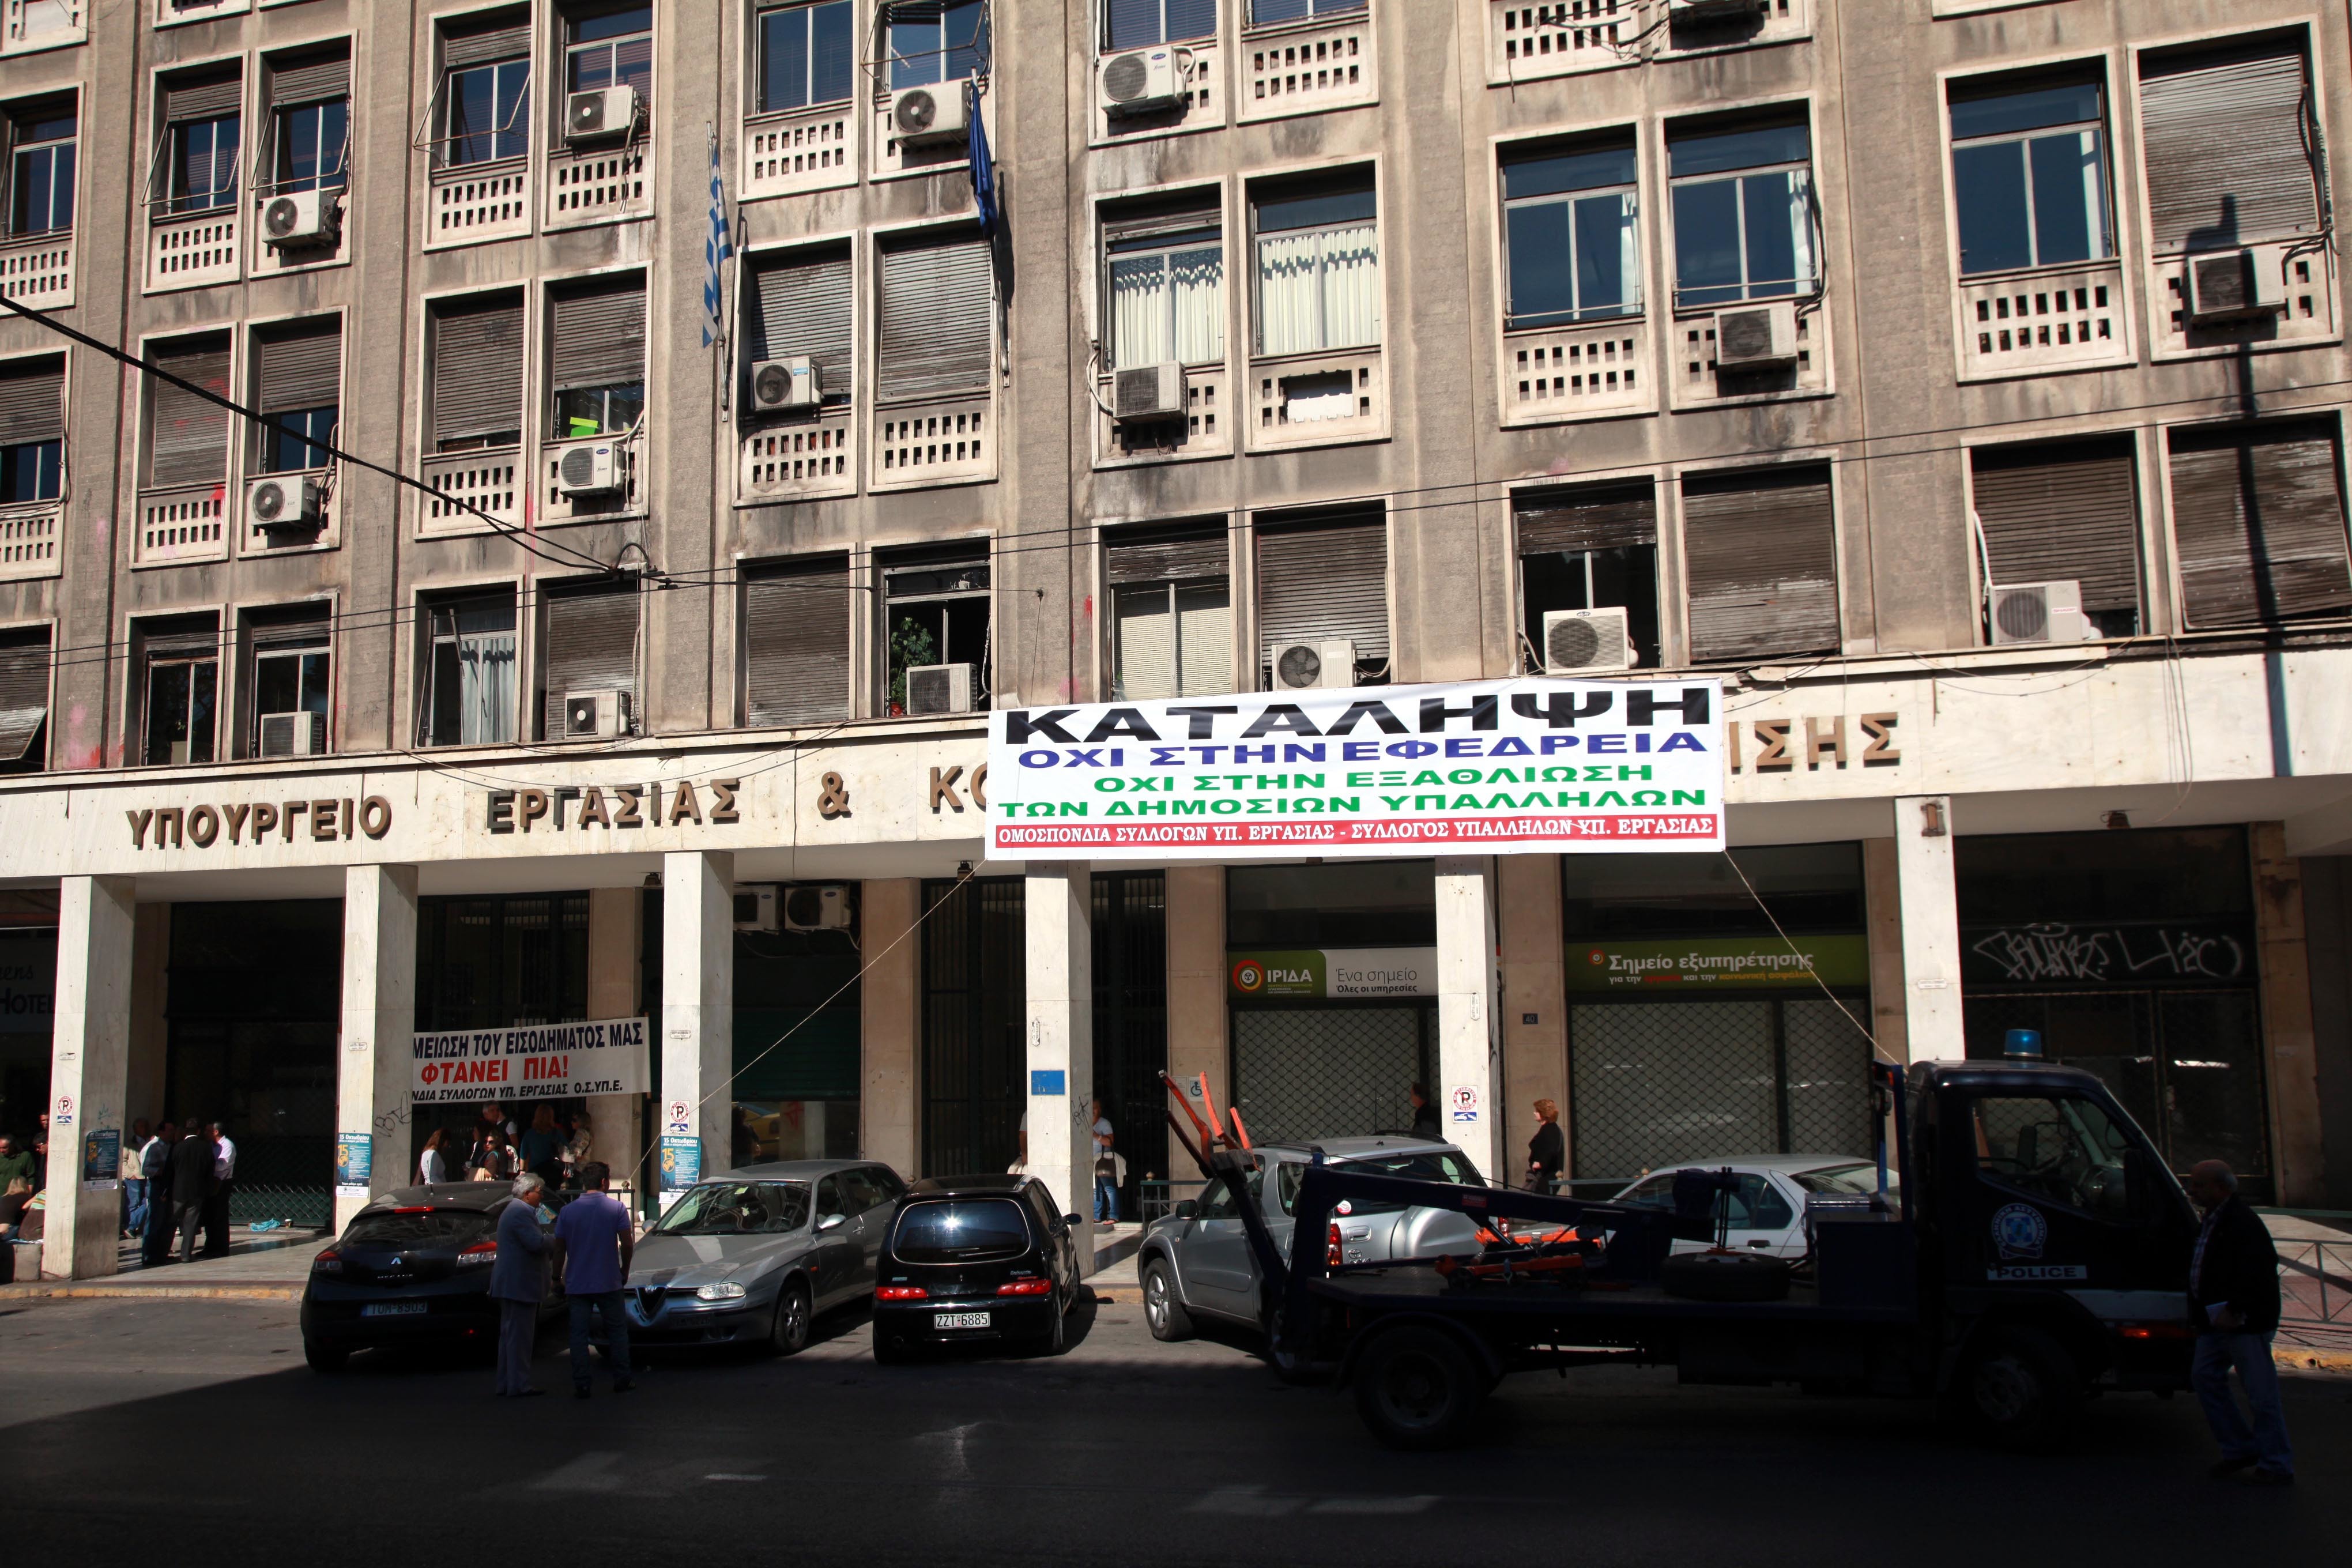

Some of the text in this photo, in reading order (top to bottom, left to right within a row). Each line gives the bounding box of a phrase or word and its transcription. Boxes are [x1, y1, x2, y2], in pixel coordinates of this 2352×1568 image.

[1006, 688, 1710, 744] ΚΑΤΑΛΗΨΗ
[1018, 732, 1707, 768] ΟΧΙ ΣΤΗΝ ΕΦΕΔΡΕΙΑ
[1094, 764, 1653, 792] ΟΧΙ ΣΤΗΝ ΕΞΑΘΛΙΩΣΗ
[126, 794, 392, 850] ΥΠΟΥΡΓΕΙΟ
[487, 778, 741, 834] ΕΡΓΑΣΙΑΣ
[817, 771, 850, 820] &
[998, 790, 1705, 817] ΤΩΝ ΔΗΜΟΣΙΩΝ ΥΠΑΛΛΗΛΩΝ
[998, 828, 1111, 843] ΟΜΟΣΠΟΝΔΙΑ
[1115, 826, 1208, 842] ΣΥΛΛΟΓΩΝ
[1213, 826, 1242, 840] ΥΠ.
[1249, 824, 1335, 840] ΕΡΓΑΣΙΑΣ
[1351, 823, 1449, 839] ΣΥΛΛΟΓΟΣ
[1453, 820, 1573, 837] ΥΠΑΛΛΗΛΩΝ
[1578, 819, 1611, 835] ΥΠ.
[1618, 817, 1713, 834] ΕΡΓΑΣΙΑΣ
[0, 964, 33, 981] ens
[1608, 951, 1814, 974] Σημείο εξυπηρέτησης
[1267, 968, 1418, 984] ΙΡΙΔΑ Ένα σημείο
[1609, 975, 1623, 985] για
[1626, 974, 1642, 984] την
[1683, 973, 1698, 981] και
[1700, 973, 1717, 982] την
[1718, 971, 1766, 982] κοινωνική
[1336, 984, 1359, 993] Όλες
[1370, 983, 1418, 994] υπηρεσίες
[0, 987, 55, 1015] HOTEL
[473, 1033, 503, 1057] ΤΟΥ
[506, 1025, 605, 1054] ΕΙΣΟΔΗΜΑΤΟΣ
[609, 1022, 643, 1047] ΜΑΣ
[421, 1055, 568, 1085] ΦΤΑΝΕΙ ΠΙΑ!
[439, 1087, 496, 1101] ΣΥΛΛΟΓΩΝ
[499, 1085, 517, 1098] ΥΠ.
[519, 1082, 568, 1097] ΕΡΓΑΣΙΑΣ
[574, 1080, 623, 1094] Ο.Σ.ΥΠ.Ε.
[338, 1144, 349, 1156] 15
[662, 1148, 674, 1160] 15
[1997, 1267, 2076, 1278] POLICE
